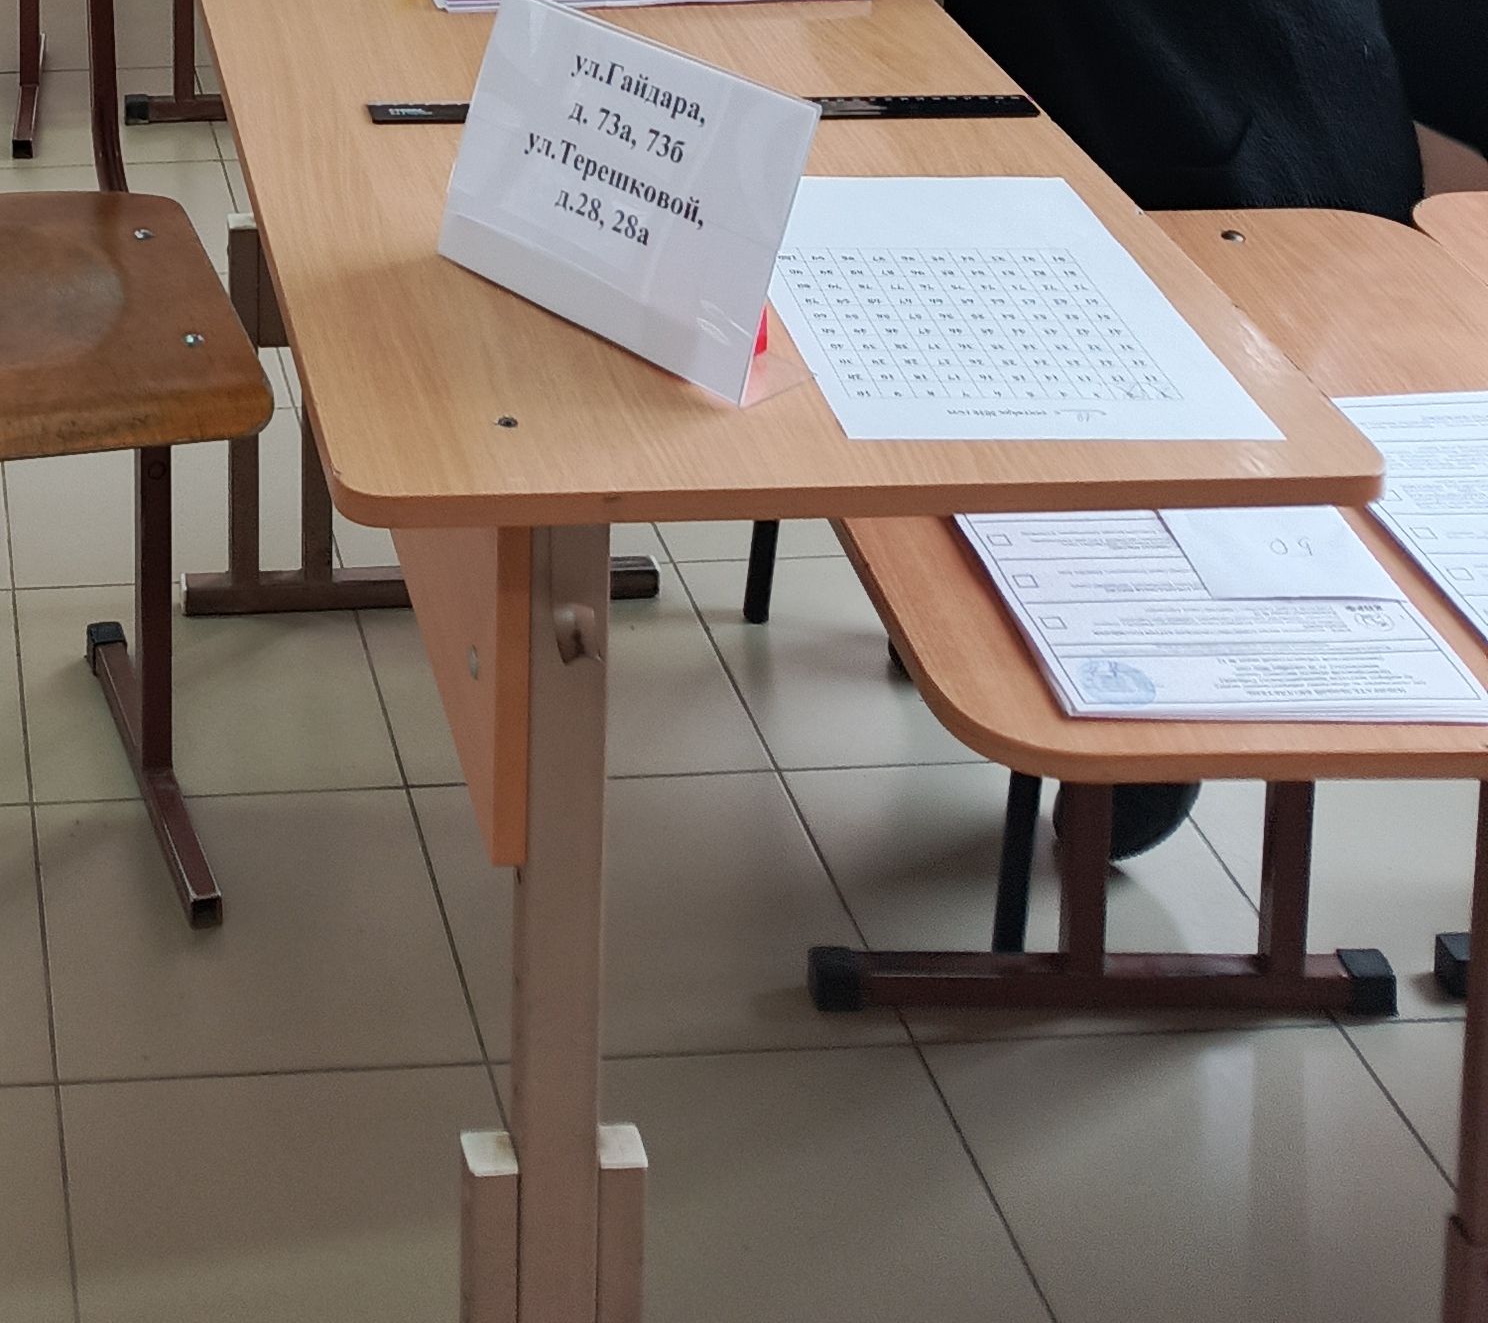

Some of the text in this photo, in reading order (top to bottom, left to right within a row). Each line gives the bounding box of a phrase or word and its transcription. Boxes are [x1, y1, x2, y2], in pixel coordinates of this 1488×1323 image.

[571, 54, 706, 128] ул.Гайдара,
[568, 103, 686, 164] д. 73а, 73б
[524, 130, 704, 230] ул.Терешковой,
[554, 185, 650, 246] д.28, 28а
